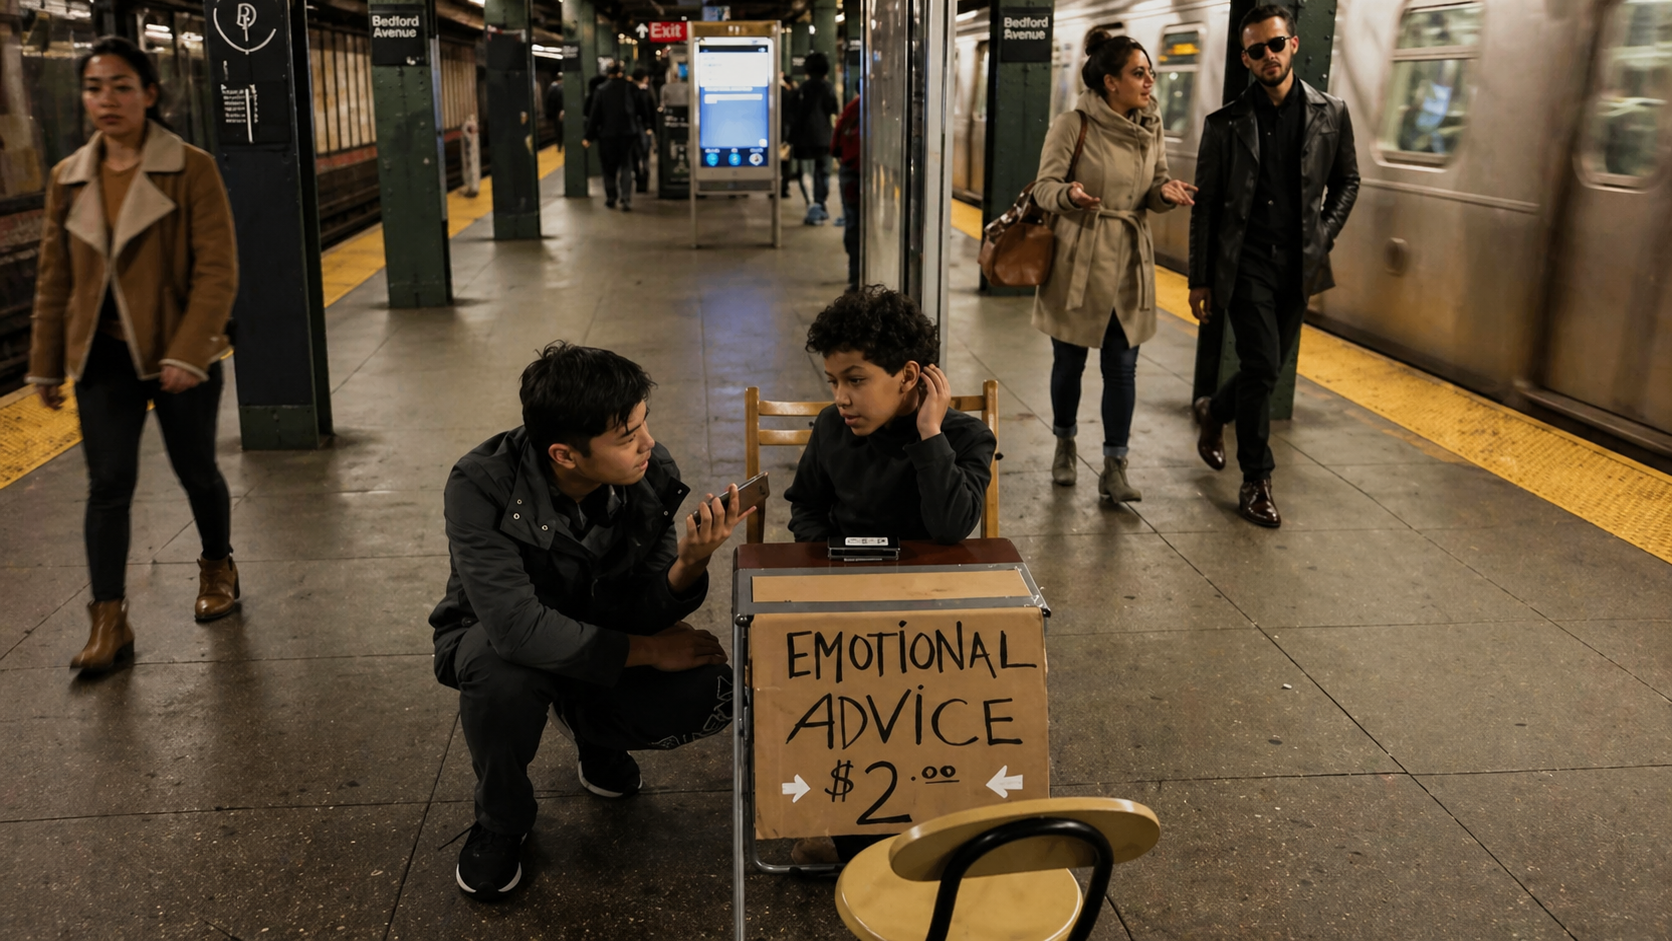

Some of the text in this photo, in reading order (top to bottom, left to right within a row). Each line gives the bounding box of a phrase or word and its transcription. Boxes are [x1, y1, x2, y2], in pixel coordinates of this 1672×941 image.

[372, 15, 419, 27] Bedford
[1004, 16, 1048, 28] Bedford
[373, 27, 417, 38] Avenue
[651, 22, 682, 38] Exit
[1004, 29, 1045, 40] Avenue
